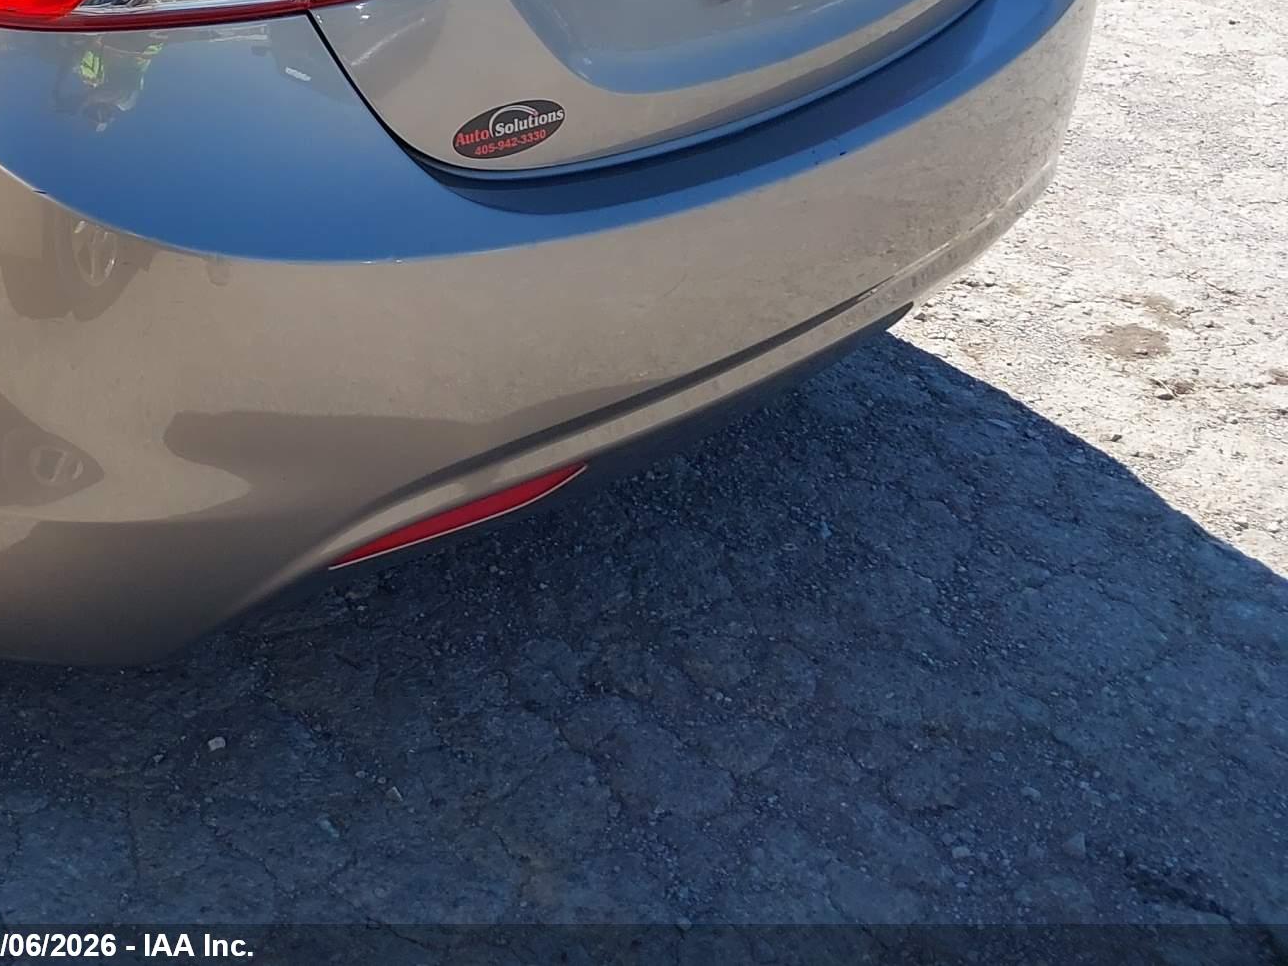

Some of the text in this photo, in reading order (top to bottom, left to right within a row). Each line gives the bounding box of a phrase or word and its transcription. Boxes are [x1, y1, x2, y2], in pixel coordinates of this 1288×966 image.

[455, 108, 564, 148] Auto Solutions
[474, 129, 547, 156] 405-942-3330
